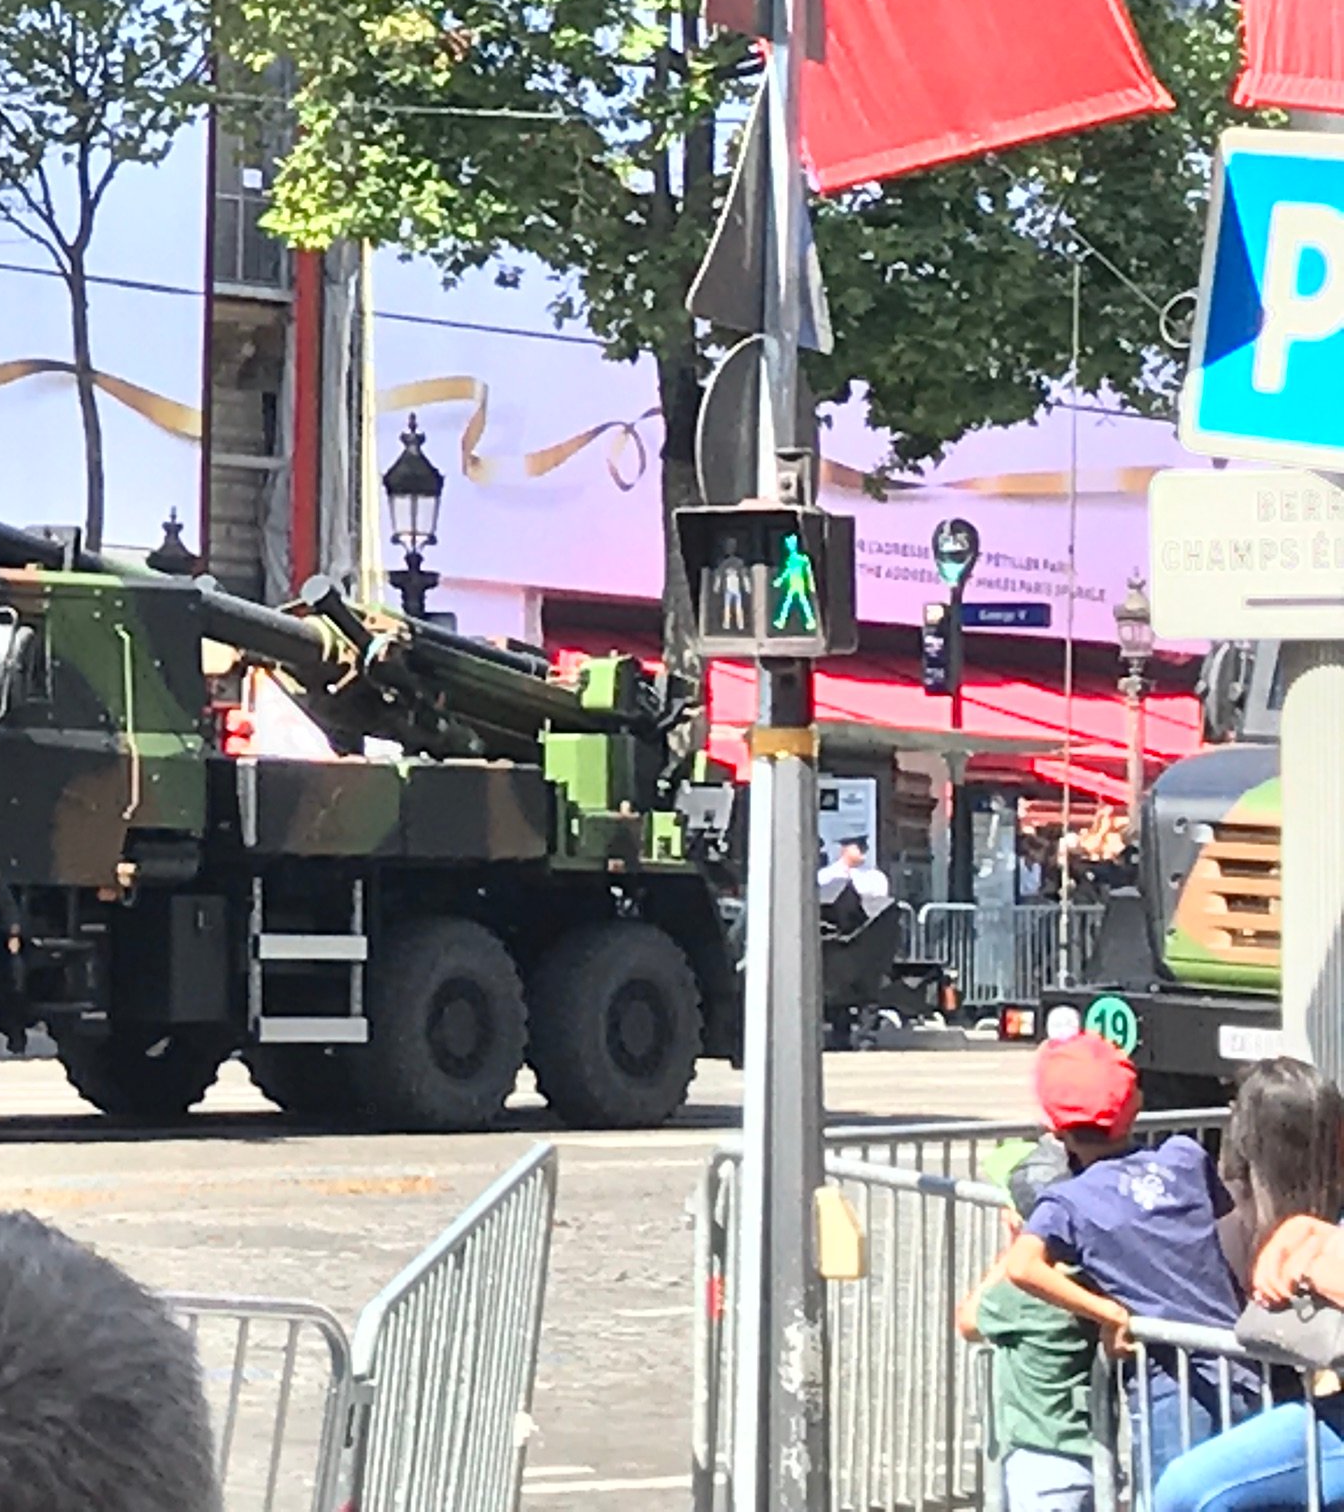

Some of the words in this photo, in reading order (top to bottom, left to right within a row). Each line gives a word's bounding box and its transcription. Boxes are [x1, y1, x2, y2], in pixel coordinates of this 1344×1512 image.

[1253, 200, 1344, 393] P
[1162, 536, 1300, 571] CHAMPS
[1094, 1008, 1129, 1050] 19
